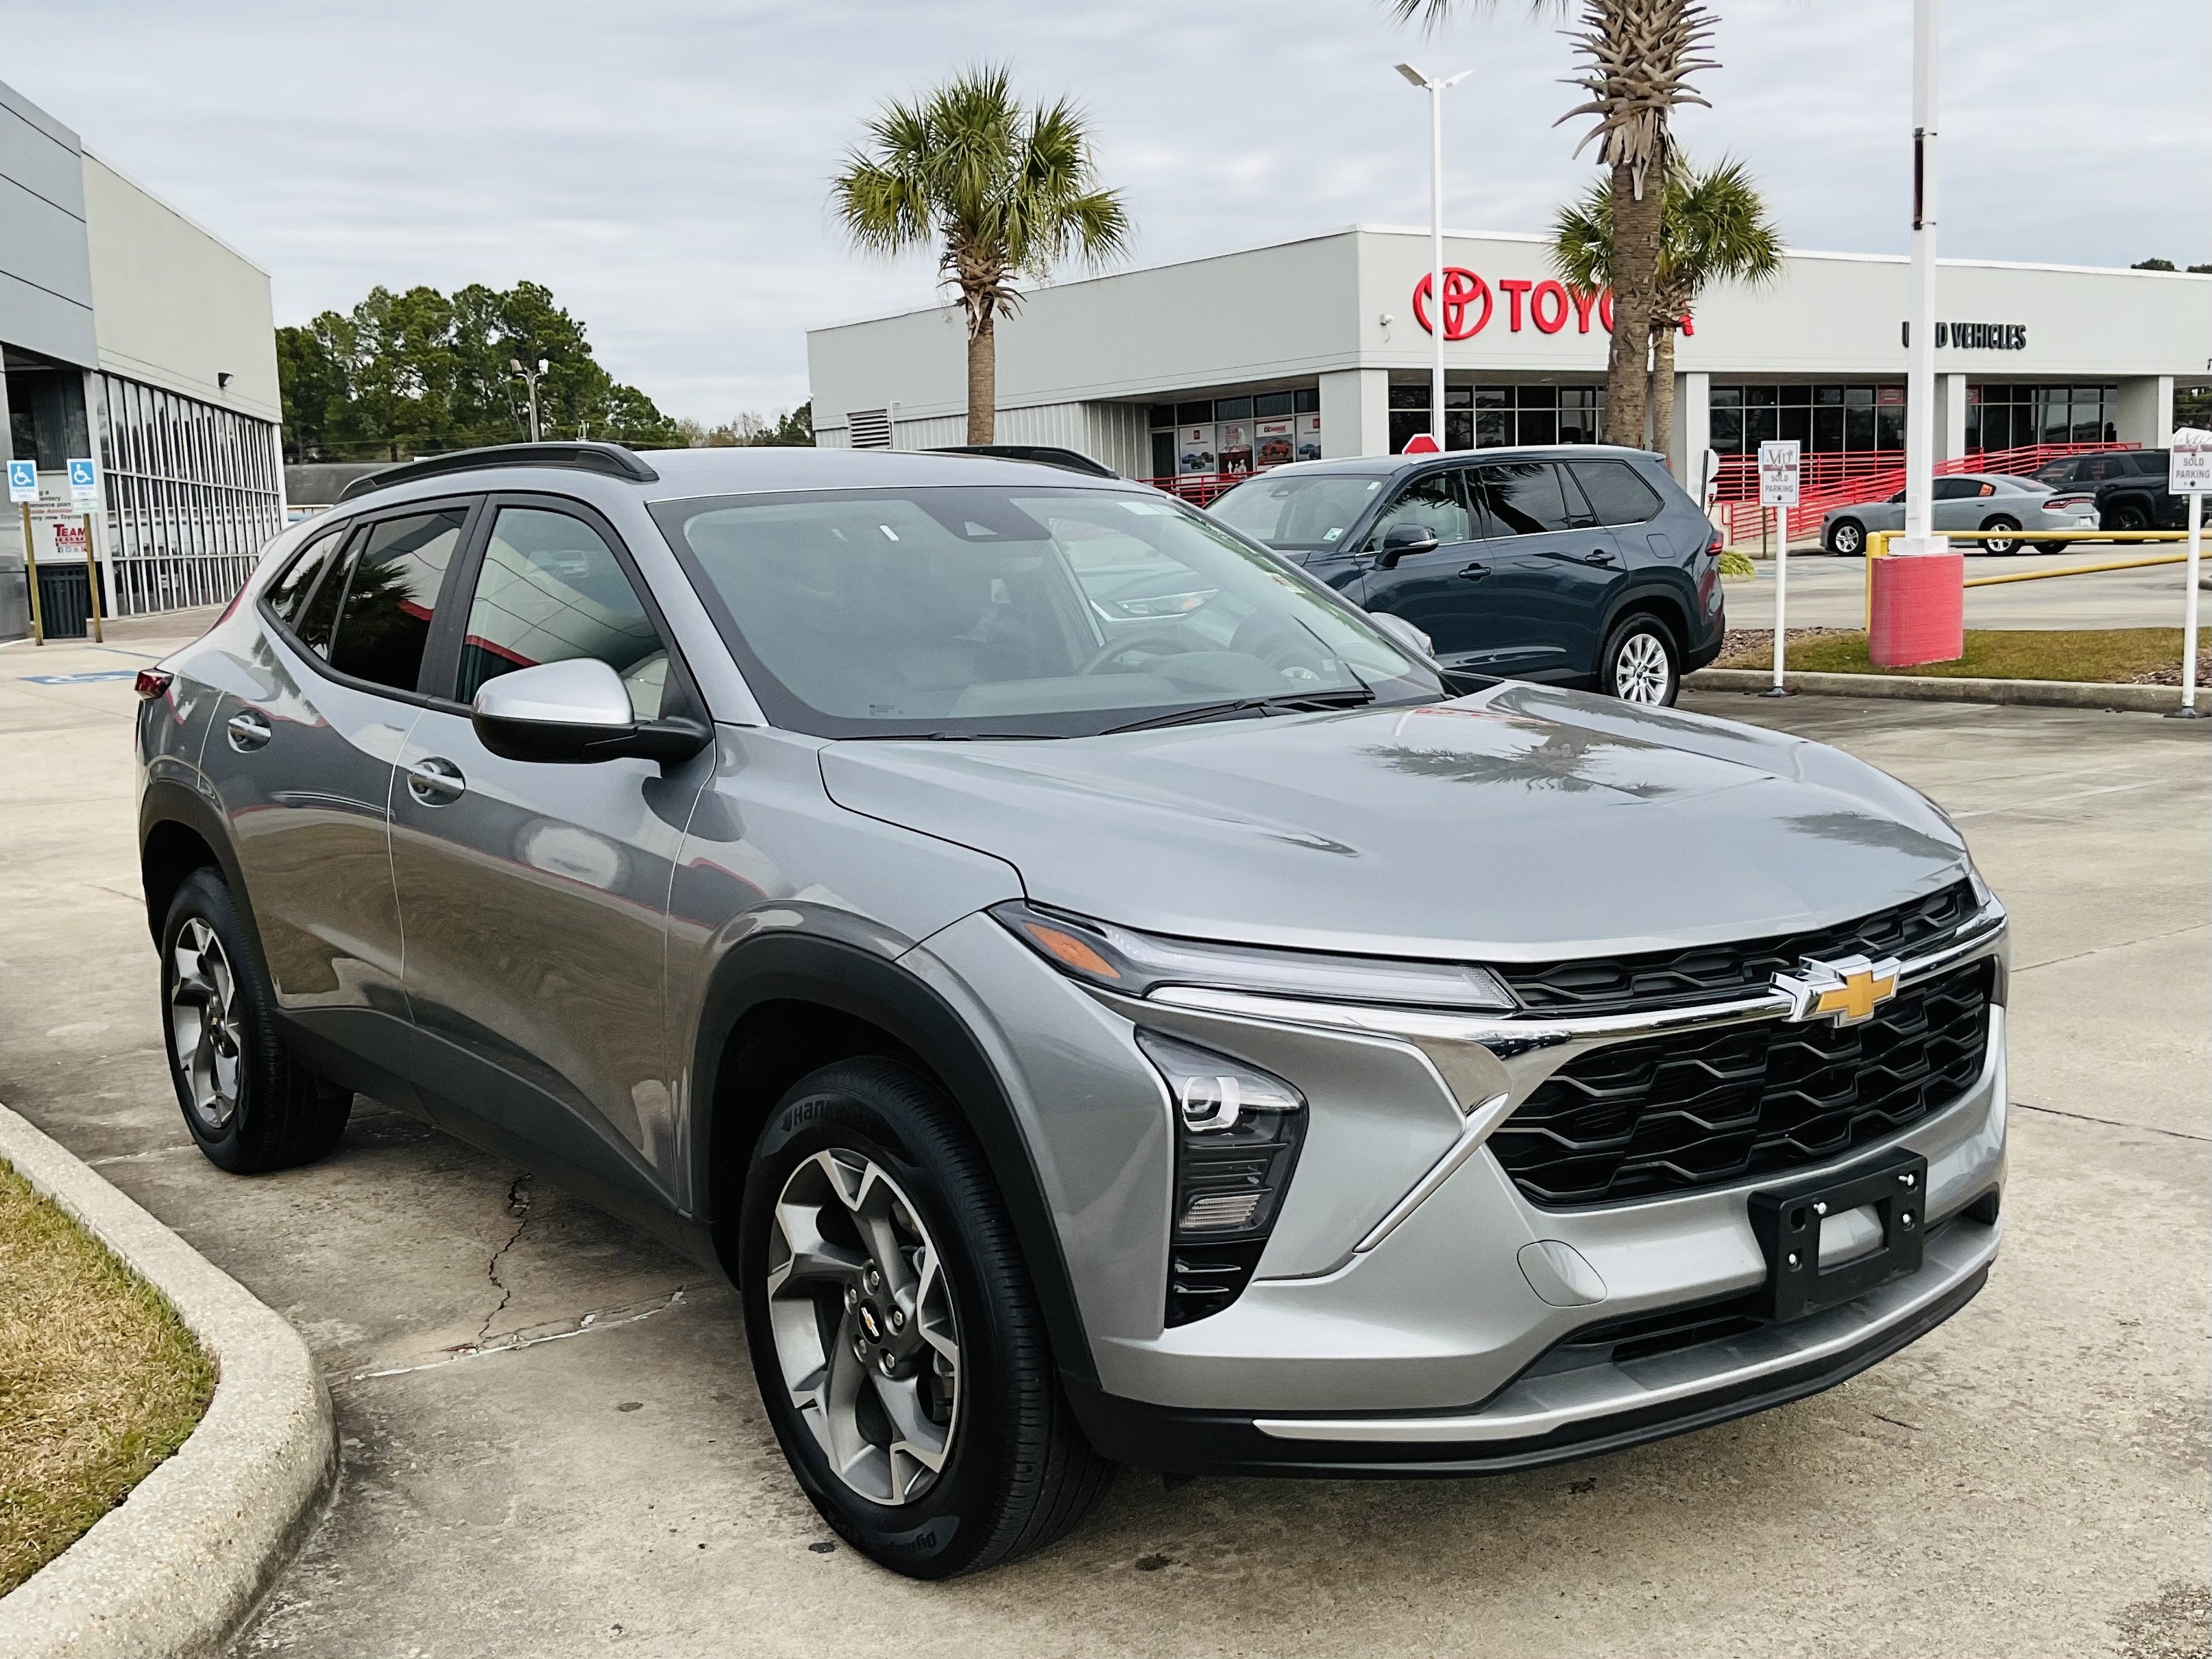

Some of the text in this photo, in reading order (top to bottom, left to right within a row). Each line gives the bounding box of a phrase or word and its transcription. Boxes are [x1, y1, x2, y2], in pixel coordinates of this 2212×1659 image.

[1950, 322, 2027, 350] VEHICLES
[2183, 457, 2204, 467] SOLD
[2176, 470, 2211, 479] PARKING
[1765, 485, 1793, 493] PARKING
